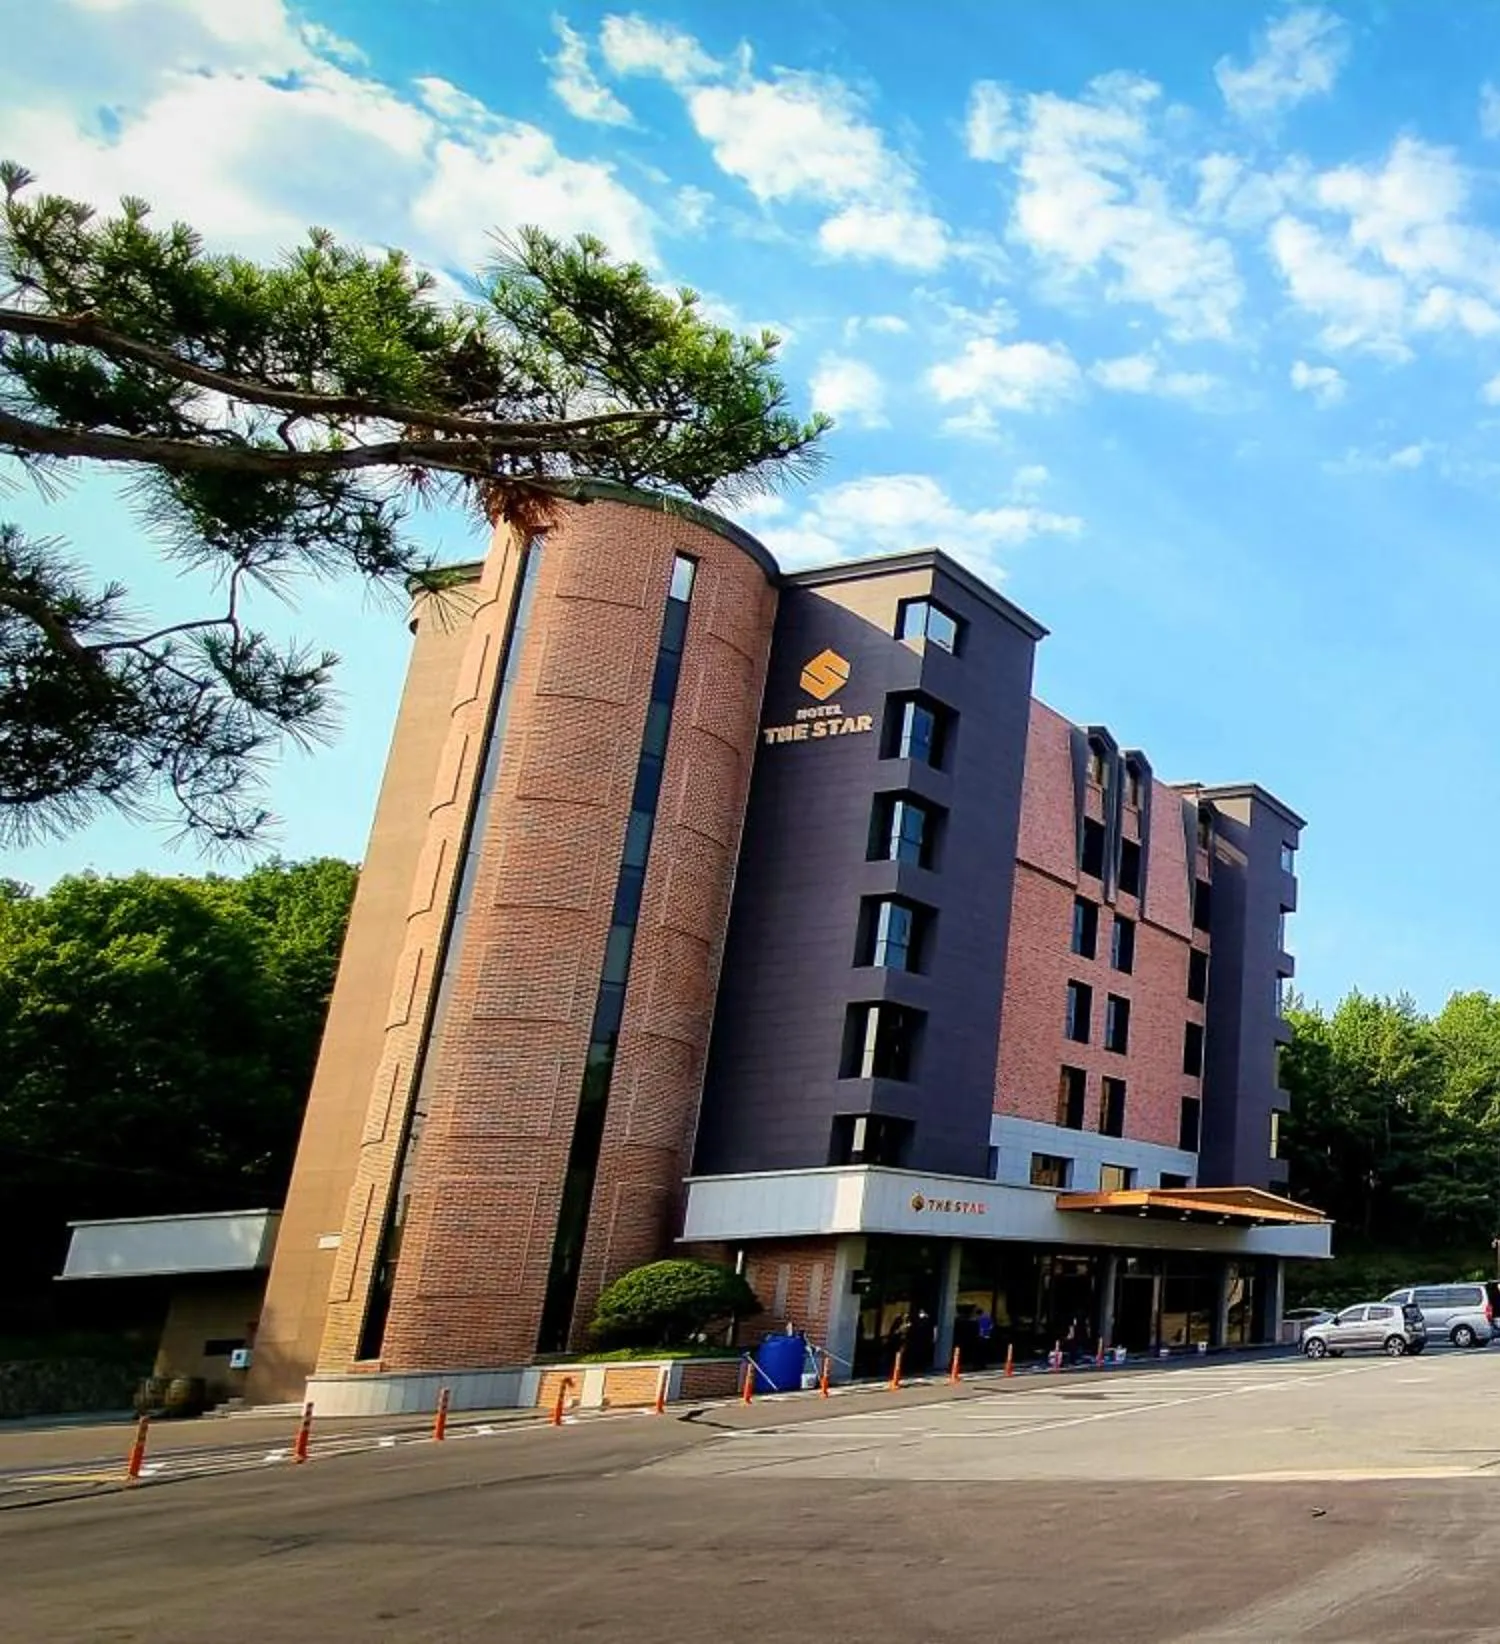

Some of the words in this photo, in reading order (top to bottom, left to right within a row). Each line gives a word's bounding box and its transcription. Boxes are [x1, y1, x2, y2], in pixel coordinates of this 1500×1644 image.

[796, 705, 843, 719] HOTEL
[764, 724, 808, 744] THE
[812, 715, 873, 737] STAR
